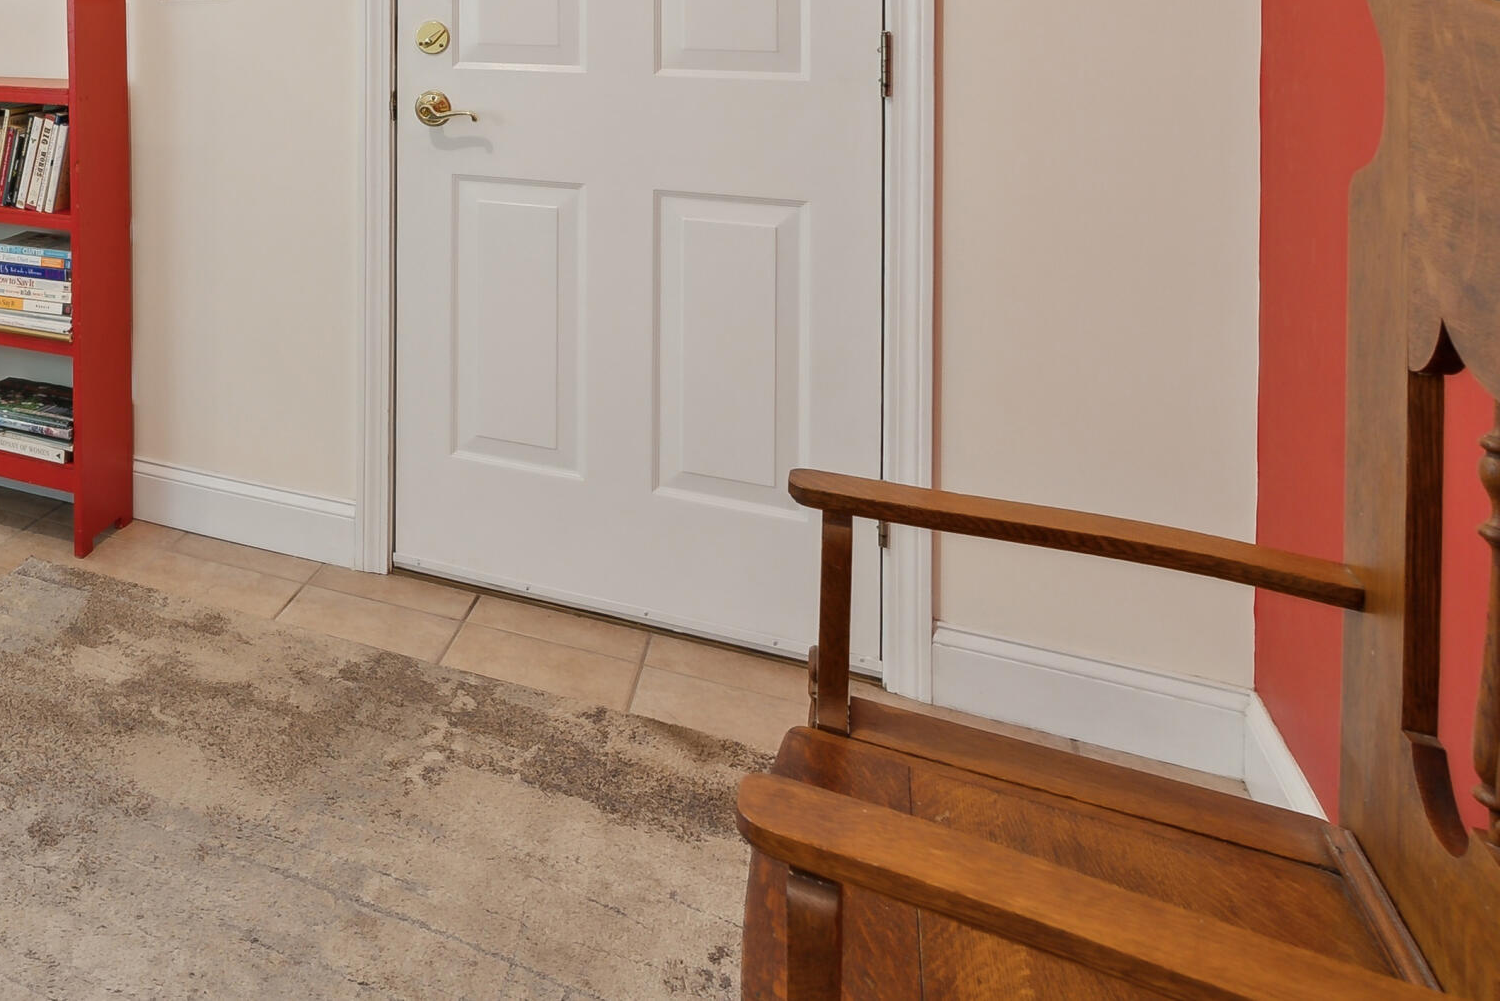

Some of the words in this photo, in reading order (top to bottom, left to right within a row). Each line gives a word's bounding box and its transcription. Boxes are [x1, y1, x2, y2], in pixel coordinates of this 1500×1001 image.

[41, 127, 51, 145] BIG
[36, 151, 47, 178] WORDS
[9, 277, 16, 285] to
[16, 278, 29, 288] Say
[29, 278, 35, 287] It
